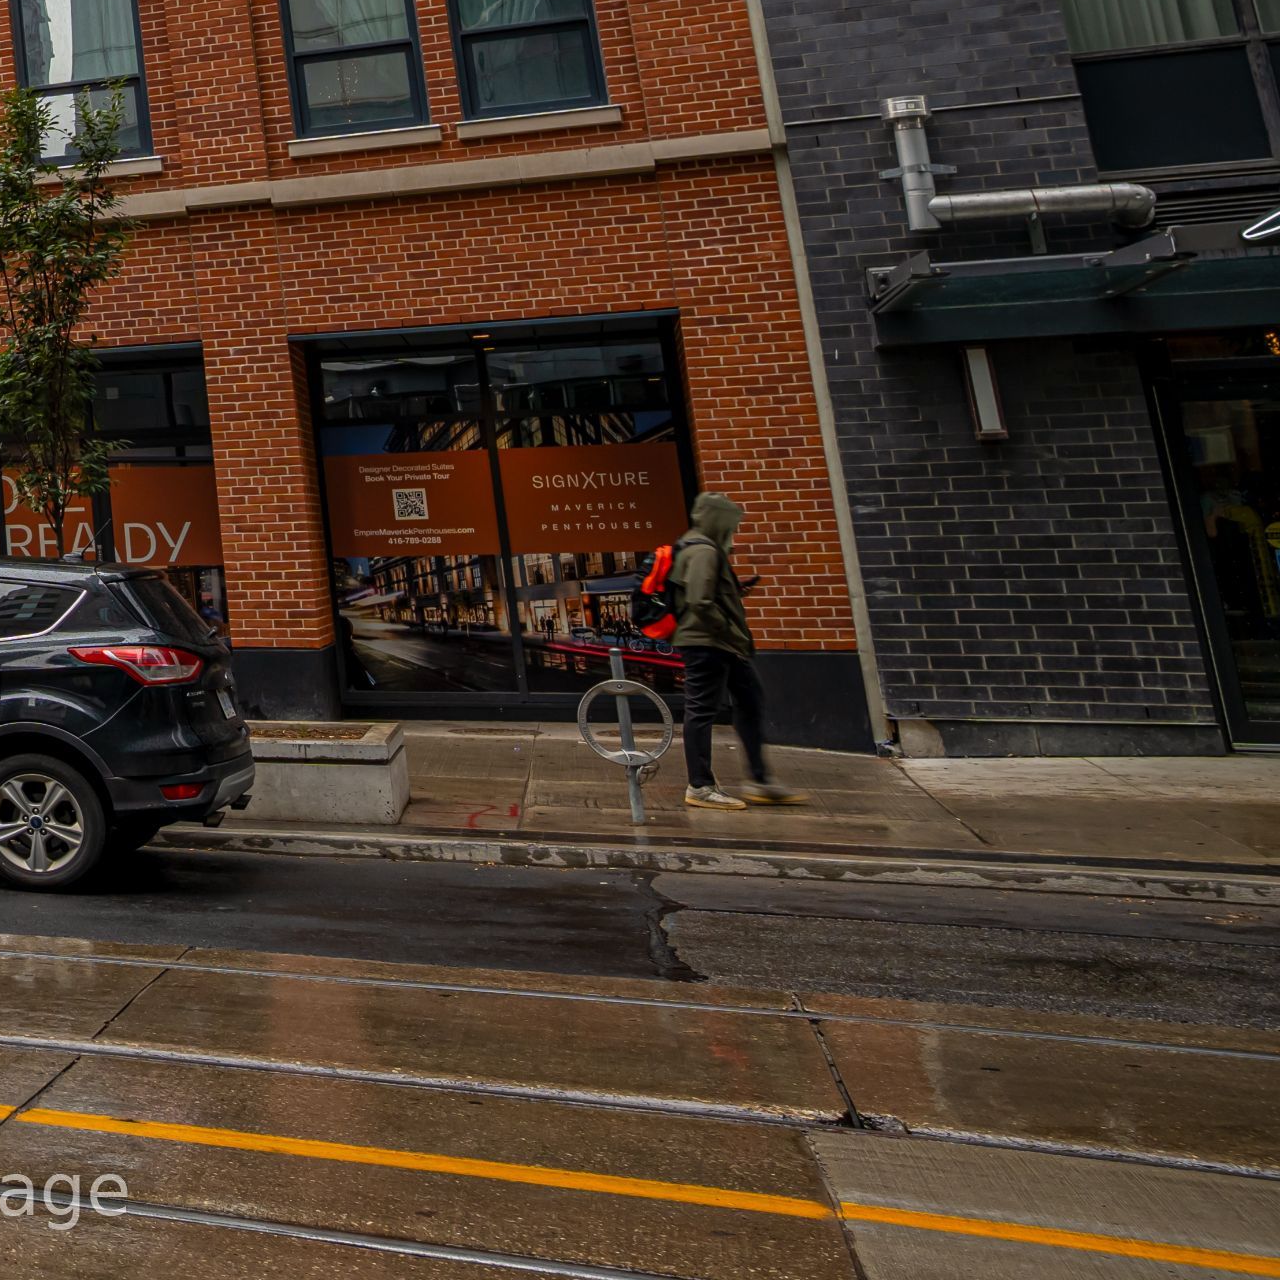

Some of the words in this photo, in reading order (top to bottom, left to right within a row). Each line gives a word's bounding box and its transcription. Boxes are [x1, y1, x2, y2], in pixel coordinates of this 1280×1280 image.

[359, 466, 391, 475] Designer
[392, 464, 430, 472] Decorated
[431, 463, 454, 471] Suites
[365, 475, 385, 483] Book
[404, 473, 431, 481] Private
[532, 471, 650, 489] SIGNXTURE
[551, 502, 637, 511] MAVERICK
[541, 521, 653, 531] PENTHOUSES
[354, 527, 475, 537] EmpireMaverickPenthouses.com
[388, 536, 442, 545] 416-789-0288
